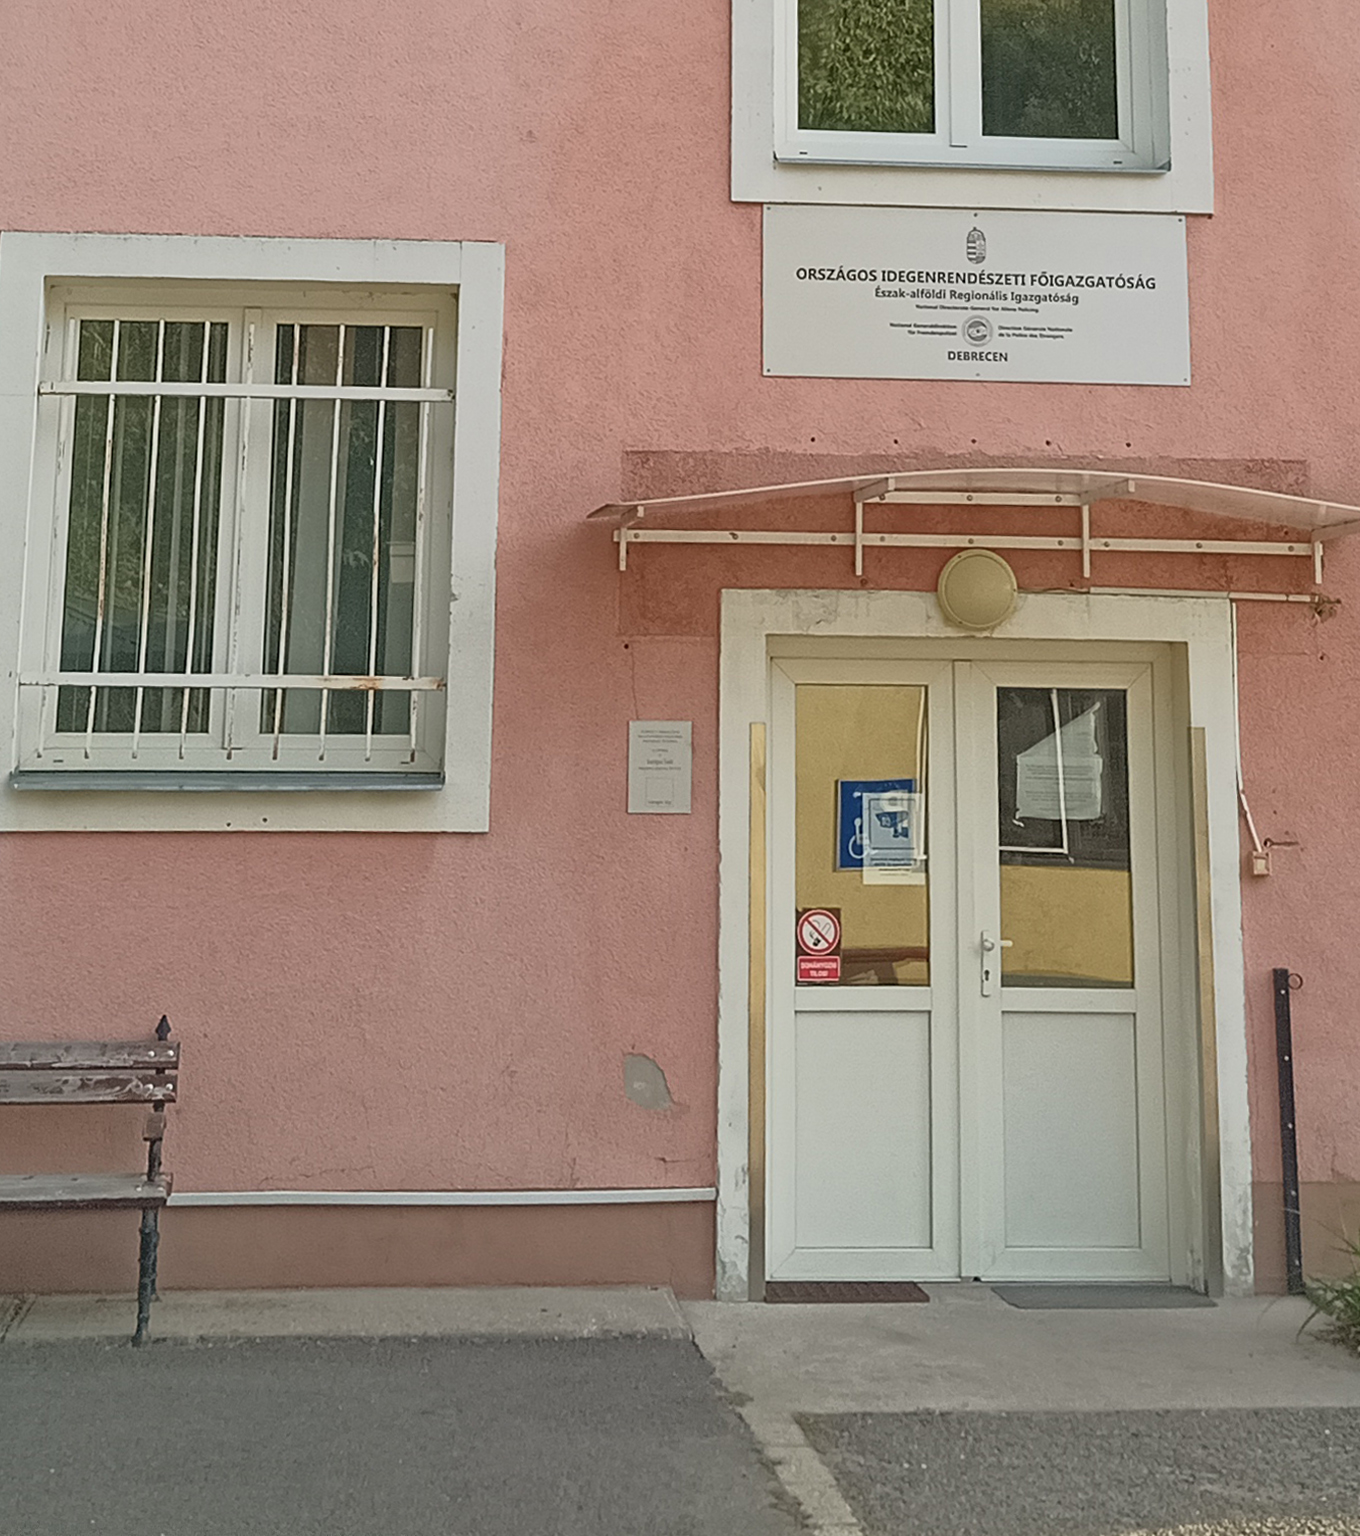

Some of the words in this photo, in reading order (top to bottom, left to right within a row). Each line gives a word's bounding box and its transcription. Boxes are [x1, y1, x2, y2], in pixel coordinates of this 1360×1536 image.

[796, 265, 878, 282] ORSZÁGOS
[881, 269, 1026, 286] IDEGENRENDÉSZETI
[1030, 271, 1156, 290] FŐIGAZGATÓSÁG
[875, 285, 946, 300] Észak-alföldi
[949, 289, 1008, 303] Regionális
[1010, 291, 1079, 306] Igazgatóság
[947, 351, 1008, 362] DEBRECEN
